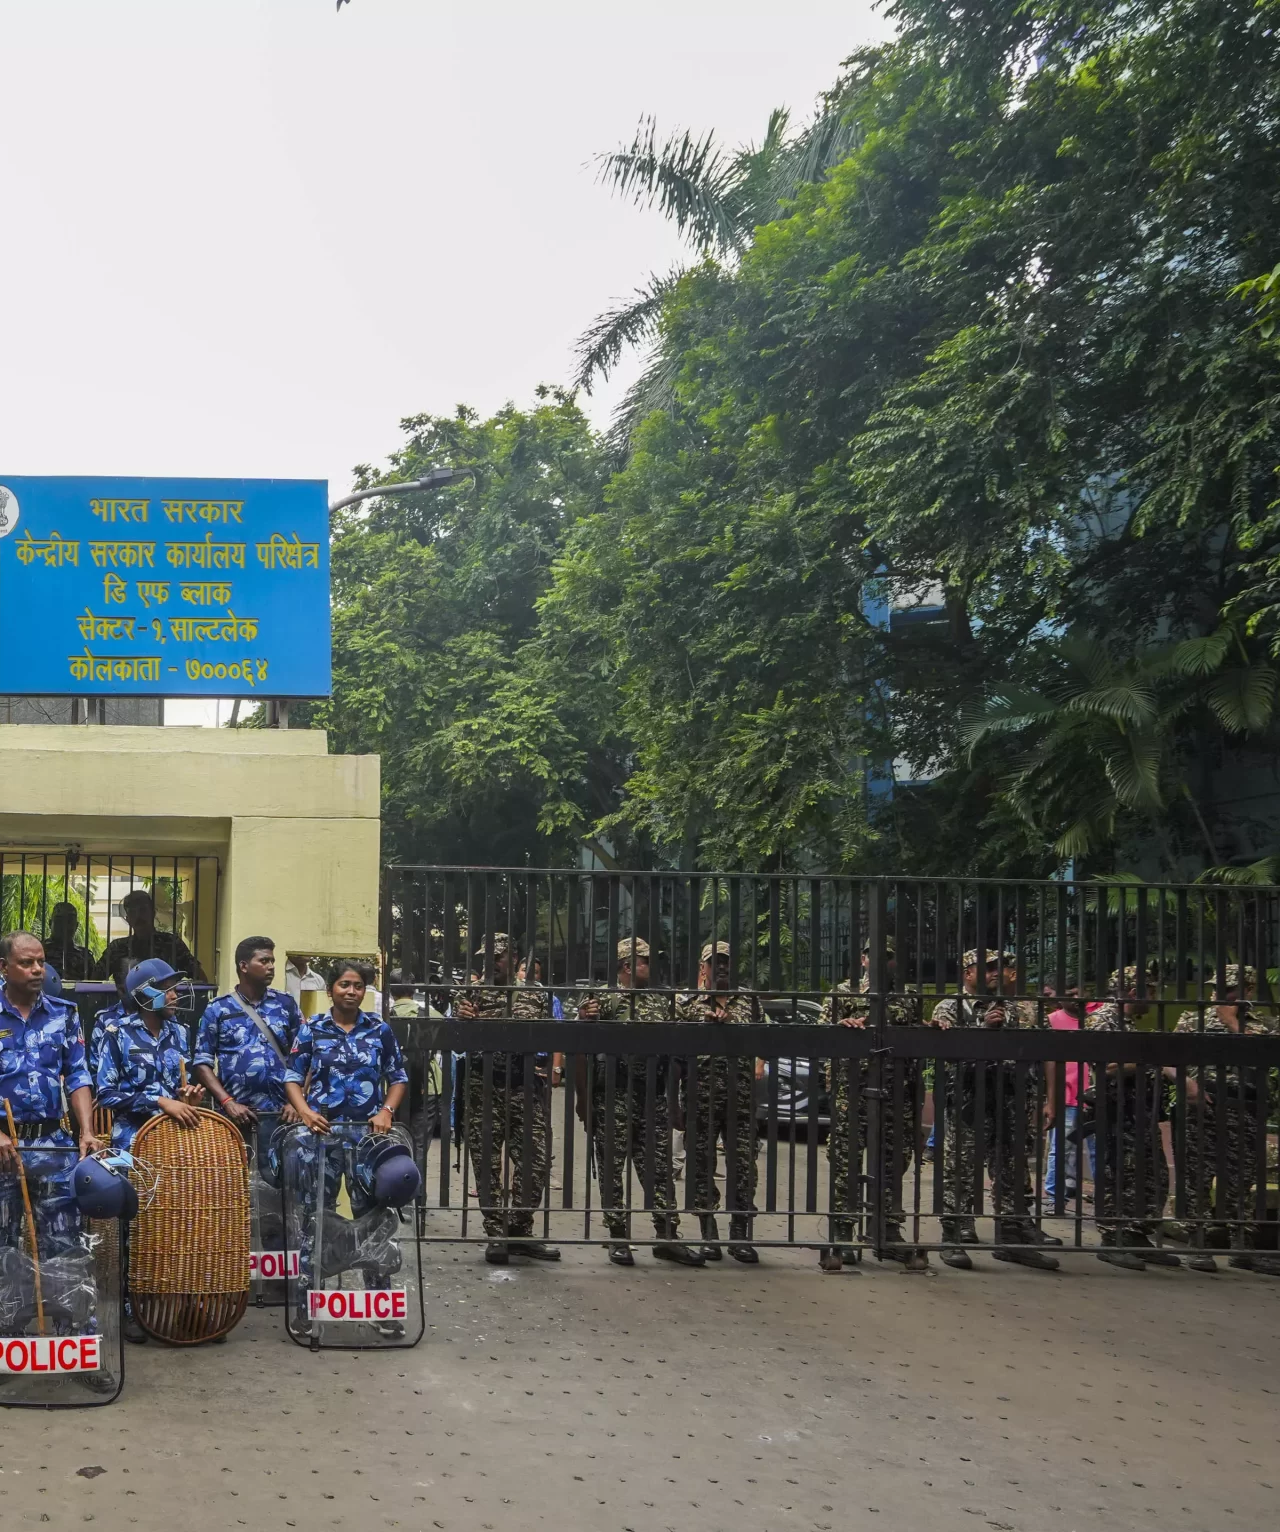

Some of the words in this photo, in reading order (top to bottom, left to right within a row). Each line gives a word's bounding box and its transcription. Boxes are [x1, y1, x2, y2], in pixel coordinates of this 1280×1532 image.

[89, 498, 150, 522] भारत
[161, 499, 244, 523] सरकार
[14, 527, 80, 567] केन्द्रीय
[88, 540, 157, 568] सरकार
[165, 531, 247, 569] कार्यालय
[255, 531, 320, 569] परिक्षेत्र
[102, 571, 127, 604] डि
[136, 581, 170, 608] एफ
[180, 581, 232, 605] ब्लाक
[68, 645, 162, 681] कोलकाता
[185, 657, 269, 687] ७०००६४
[249, 1252, 299, 1277] POLI
[310, 1291, 407, 1319] POLICE
